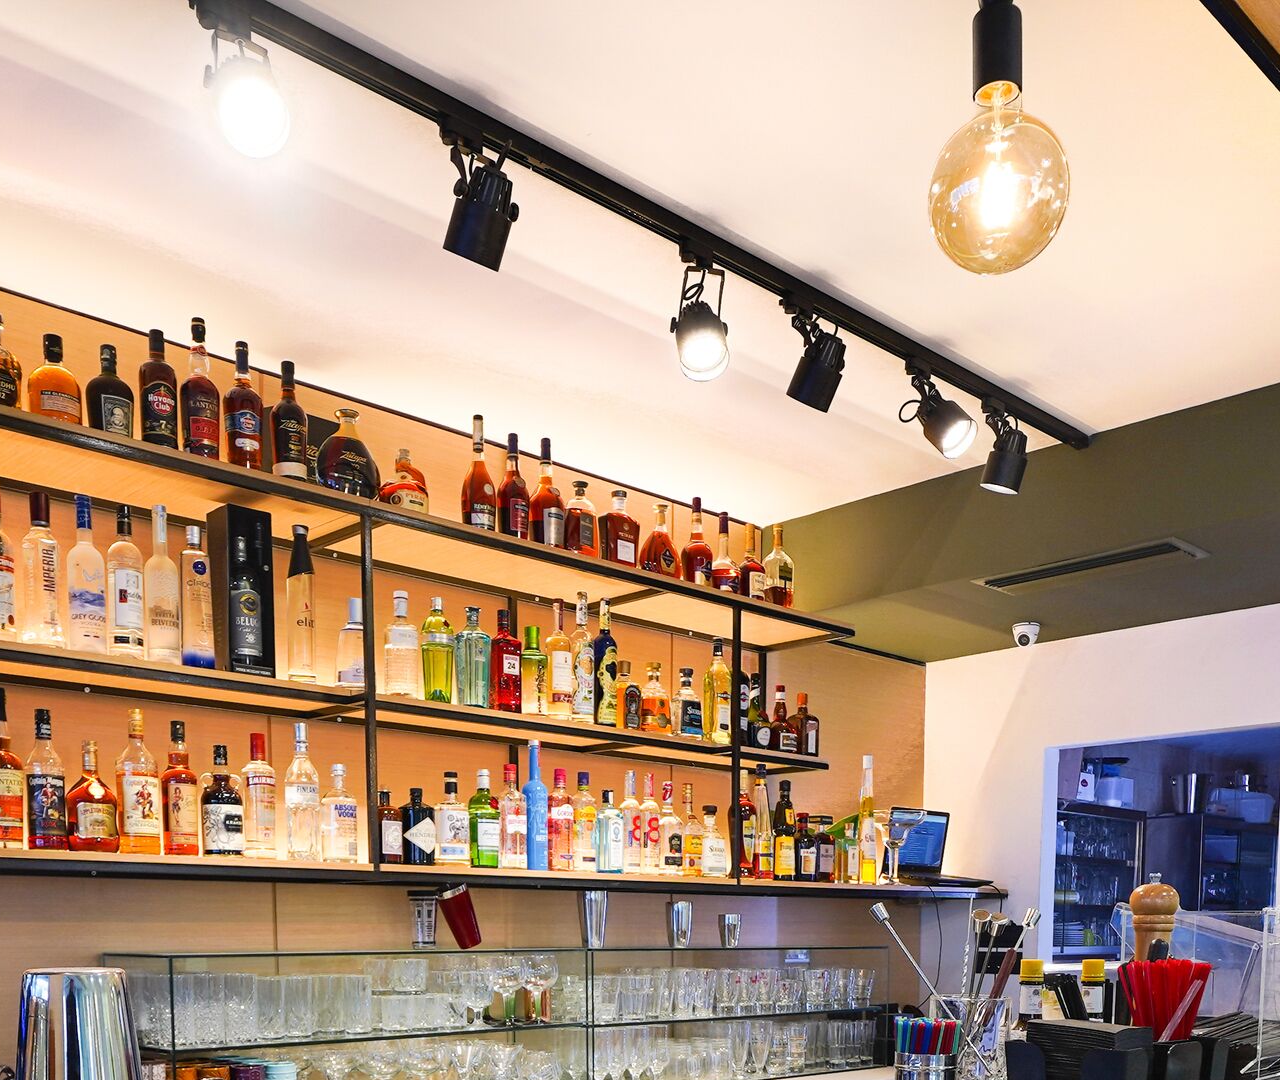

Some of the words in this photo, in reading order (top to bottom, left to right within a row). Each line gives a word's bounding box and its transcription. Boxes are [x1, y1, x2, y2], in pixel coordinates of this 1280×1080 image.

[154, 402, 171, 412] Club
[160, 420, 167, 430] 7
[507, 662, 516, 670] 24
[647, 816, 660, 843] 8
